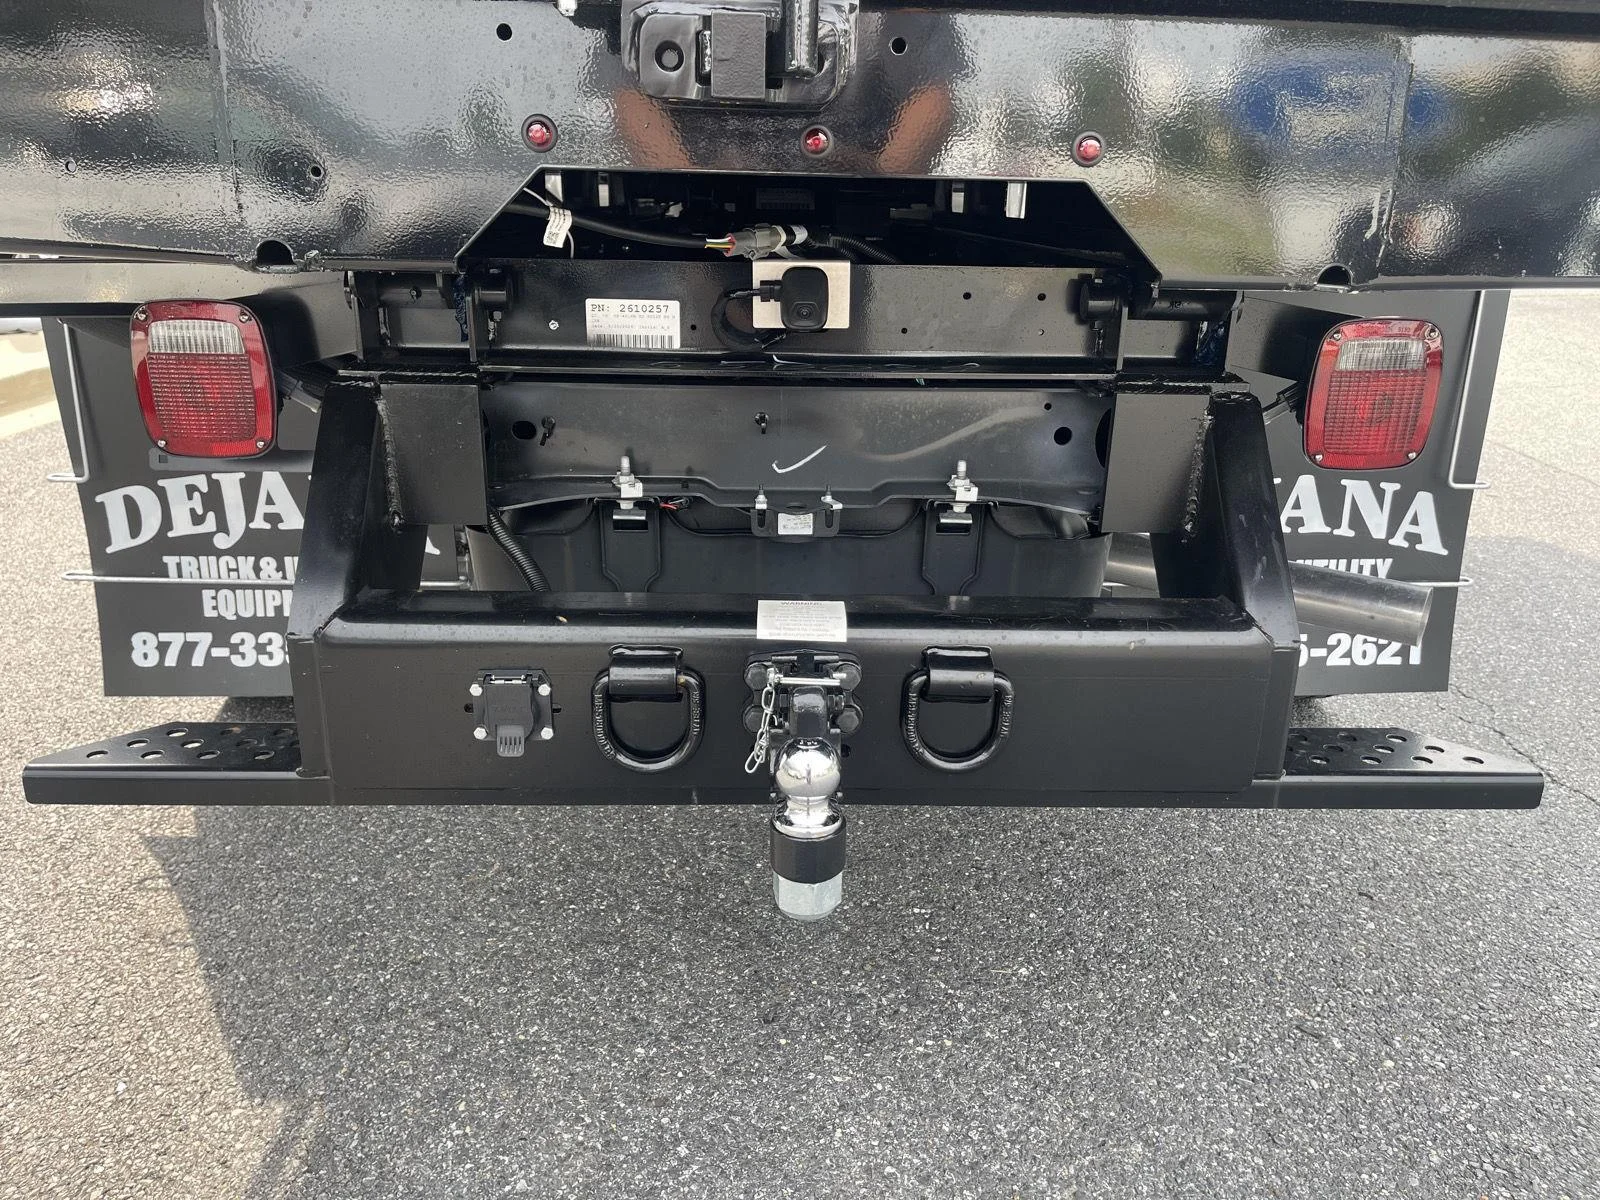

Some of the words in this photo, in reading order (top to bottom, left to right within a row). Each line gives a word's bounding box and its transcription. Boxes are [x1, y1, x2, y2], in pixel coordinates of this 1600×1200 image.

[590, 303, 611, 313] PN:
[619, 304, 669, 314] 2610257
[95, 471, 441, 555] DEJA
[1274, 474, 1449, 556] ANA
[131, 631, 290, 668] 877-33
